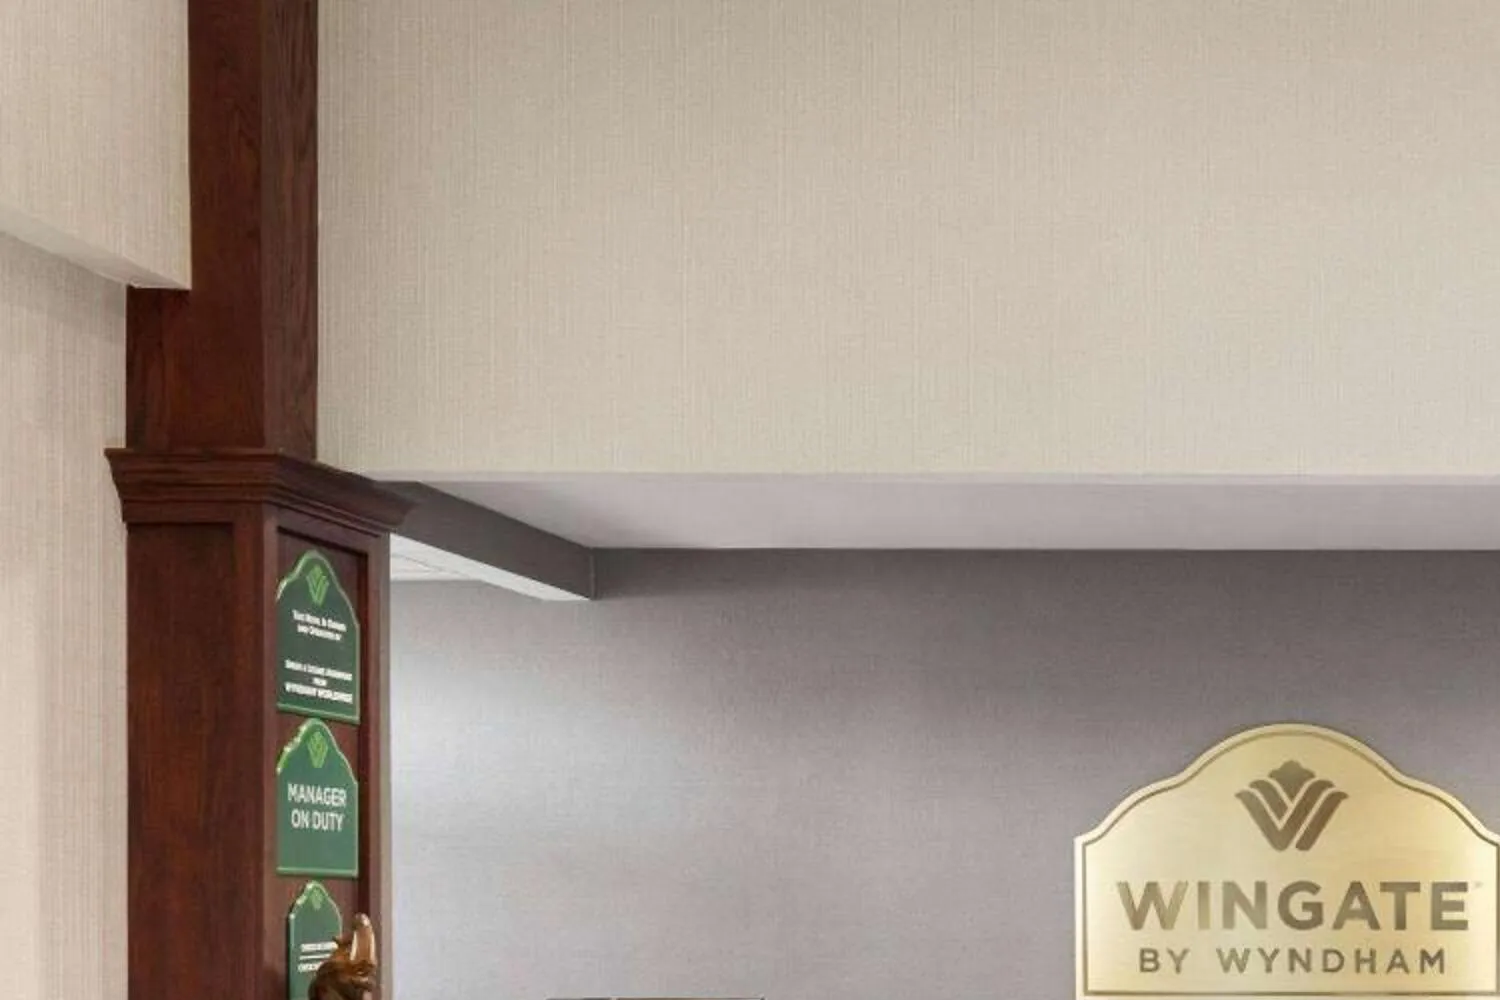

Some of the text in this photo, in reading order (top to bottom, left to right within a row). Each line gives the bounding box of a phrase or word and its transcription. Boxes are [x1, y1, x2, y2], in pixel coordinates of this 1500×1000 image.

[287, 782, 347, 808] MANAGER
[291, 808, 345, 832] ON DUTY
[1117, 881, 1469, 931] WINGATE
[1139, 947, 1446, 975] BY WYNDHAM
